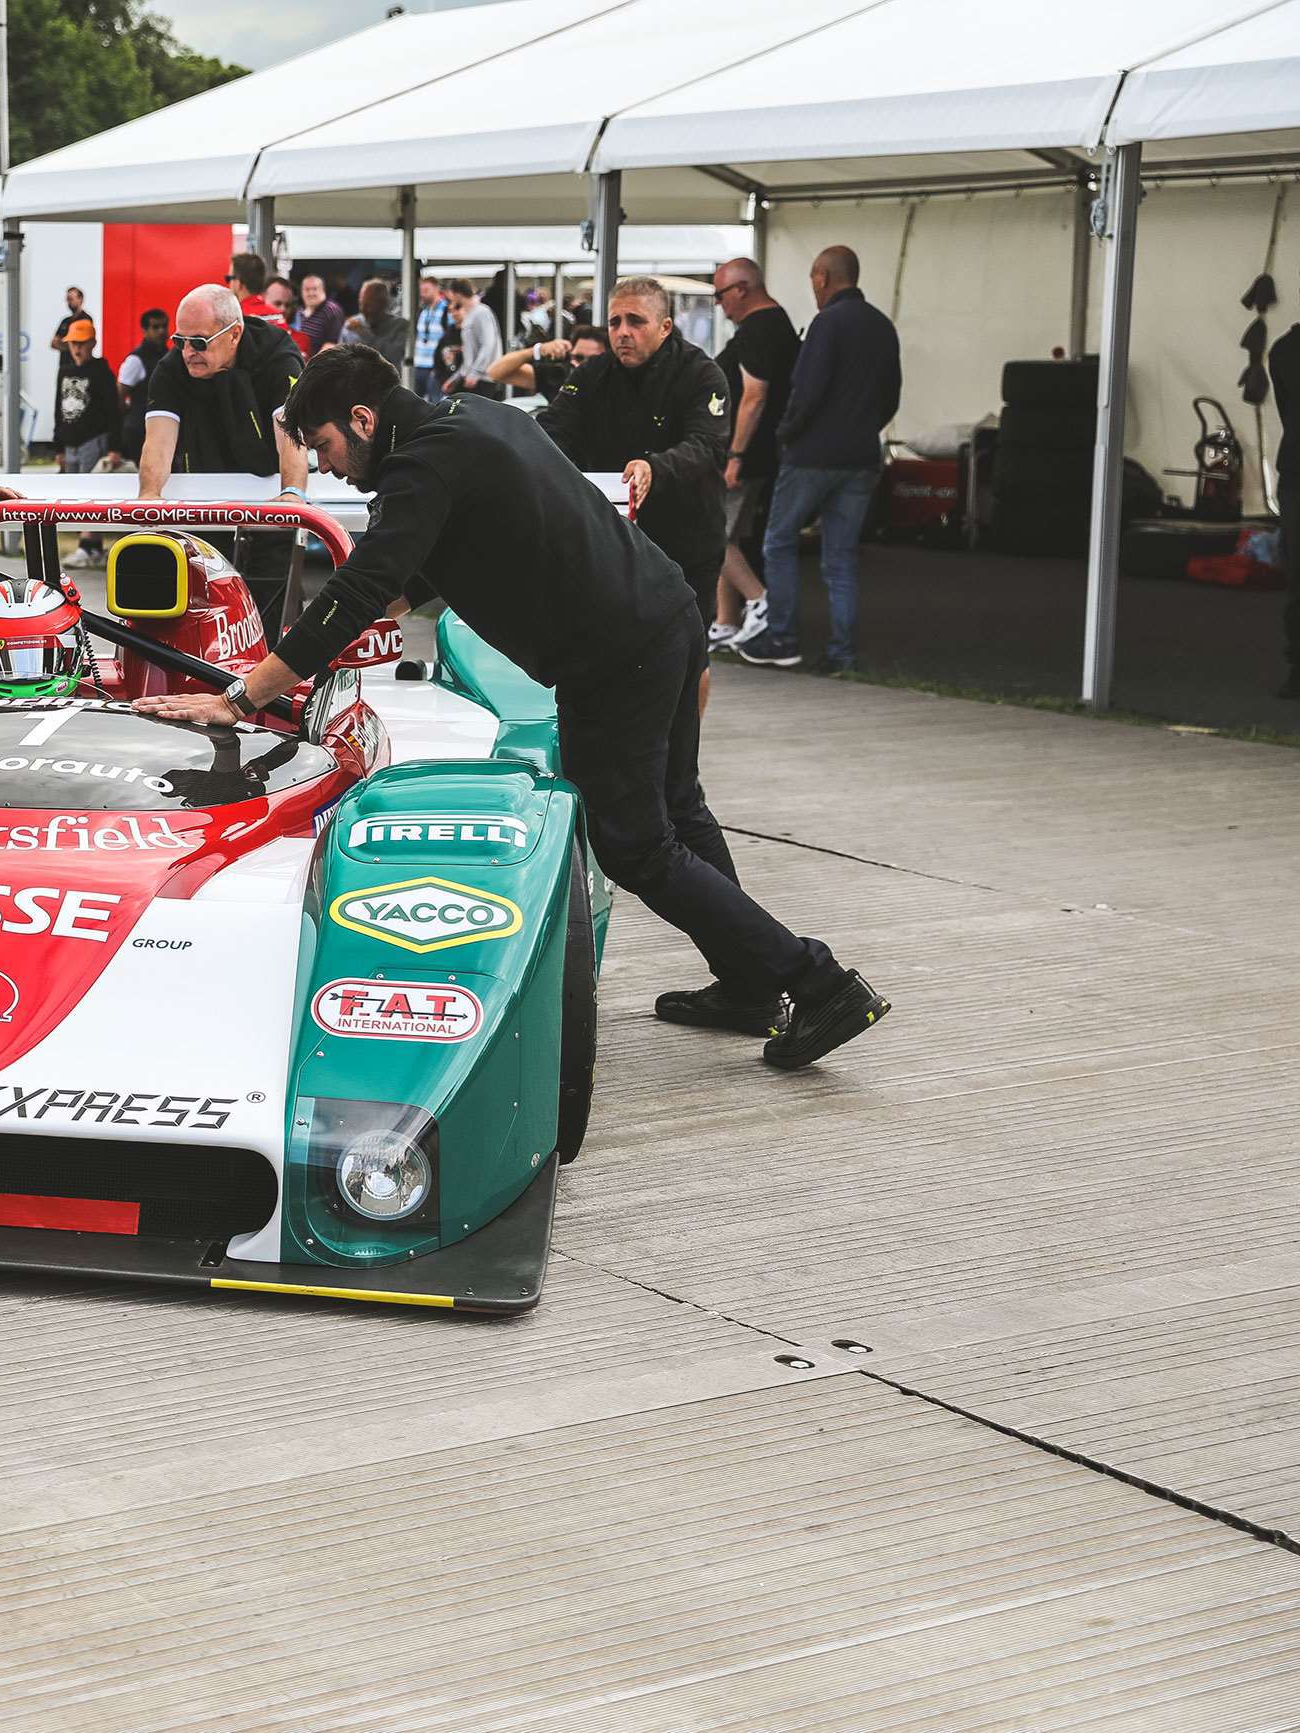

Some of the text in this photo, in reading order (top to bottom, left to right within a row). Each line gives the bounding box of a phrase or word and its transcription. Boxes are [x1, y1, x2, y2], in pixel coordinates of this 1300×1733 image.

[357, 629, 403, 658] JVC
[19, 707, 84, 747] 1
[348, 814, 528, 848] PIRELLI
[362, 902, 495, 926] YACCO
[132, 938, 193, 951] GROUP
[337, 1018, 456, 1035] INTERNATIONAL
